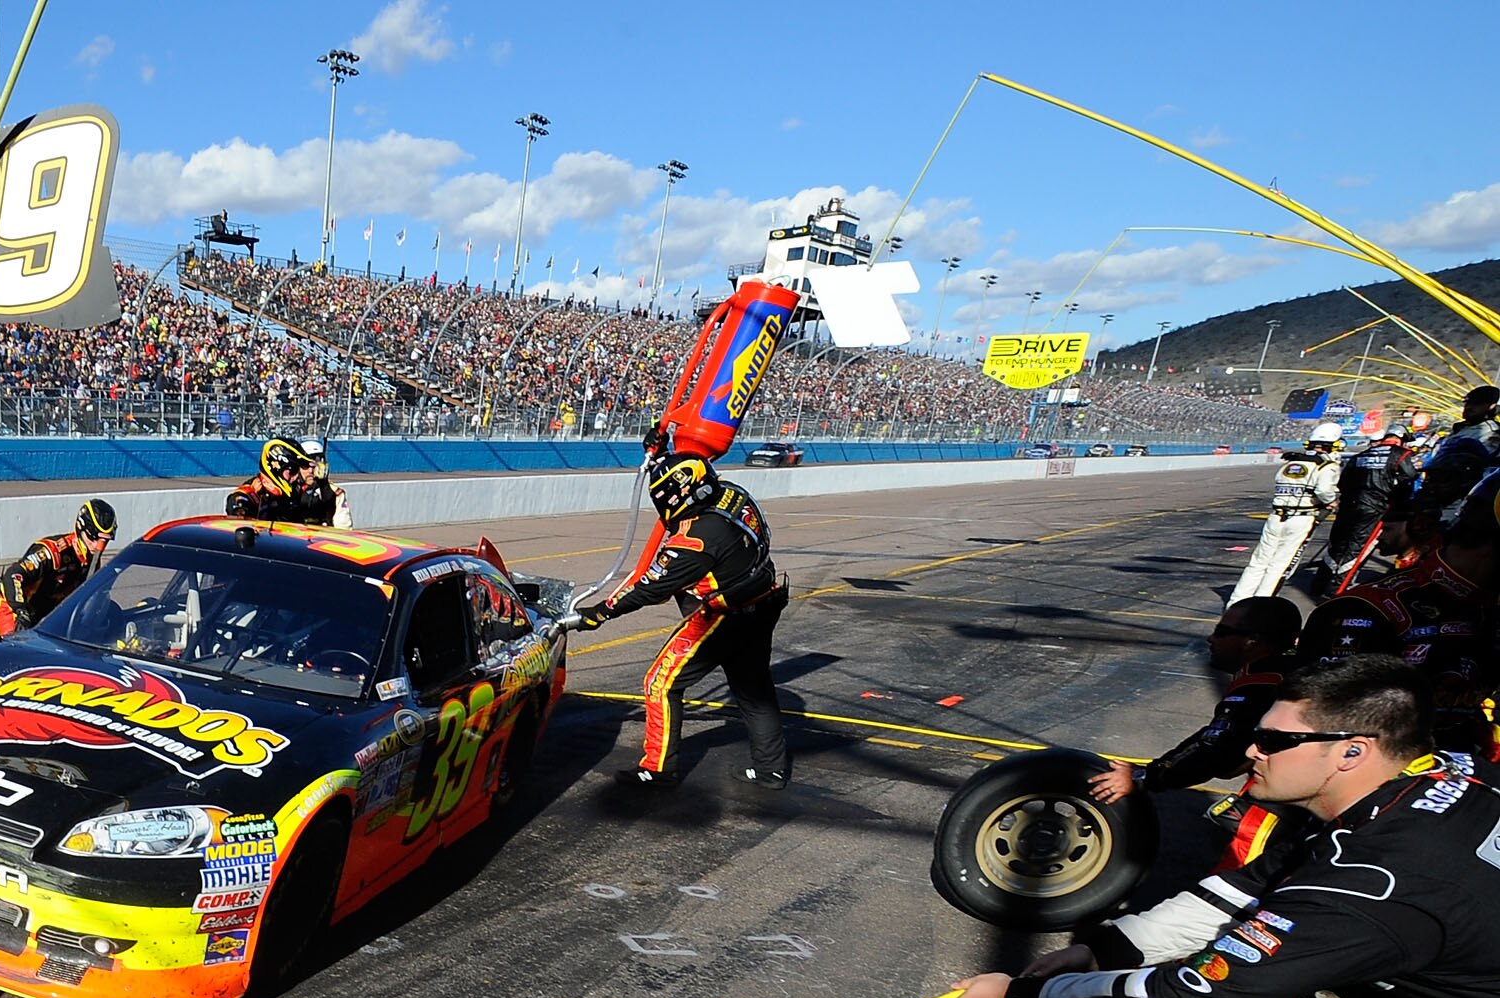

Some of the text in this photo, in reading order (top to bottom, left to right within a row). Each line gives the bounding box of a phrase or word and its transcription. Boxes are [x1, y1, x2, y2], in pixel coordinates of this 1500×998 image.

[990, 337, 1082, 357] DRIVE
[731, 319, 780, 417] SUNOCO
[990, 356, 1077, 366] TO END HUNGER
[2, 698, 113, 727] WHIRLWIND
[124, 727, 205, 762] FLAVOR!
[406, 681, 495, 838] 39
[220, 819, 275, 837] Gatorback
[205, 838, 274, 861] MOOG
[202, 863, 271, 889] MAHLE
[197, 890, 250, 910] COMP
[200, 910, 255, 930] Edelbrock
[1214, 935, 1260, 963] OREO
